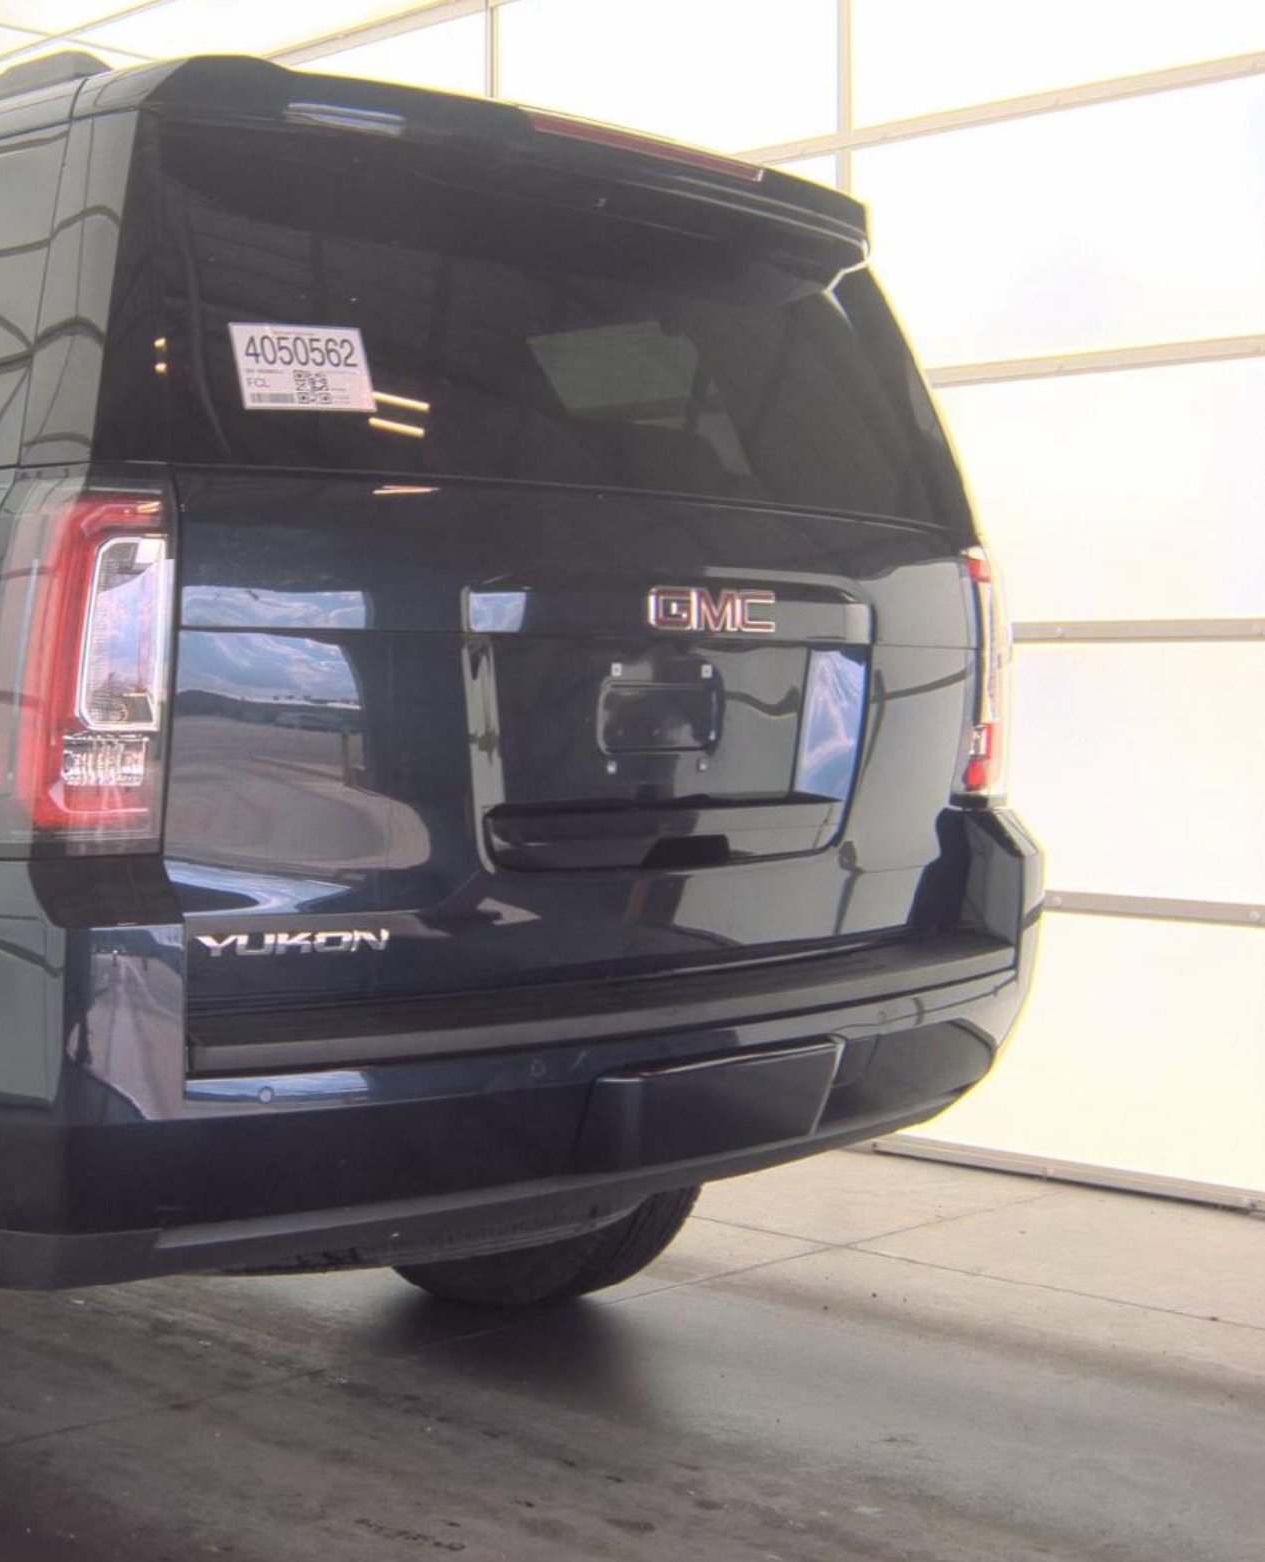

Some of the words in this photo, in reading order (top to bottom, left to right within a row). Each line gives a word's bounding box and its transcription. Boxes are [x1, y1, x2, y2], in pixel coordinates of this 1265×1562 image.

[245, 335, 358, 367] 4050562
[647, 585, 776, 633] GMC
[193, 928, 390, 957] YUKON
